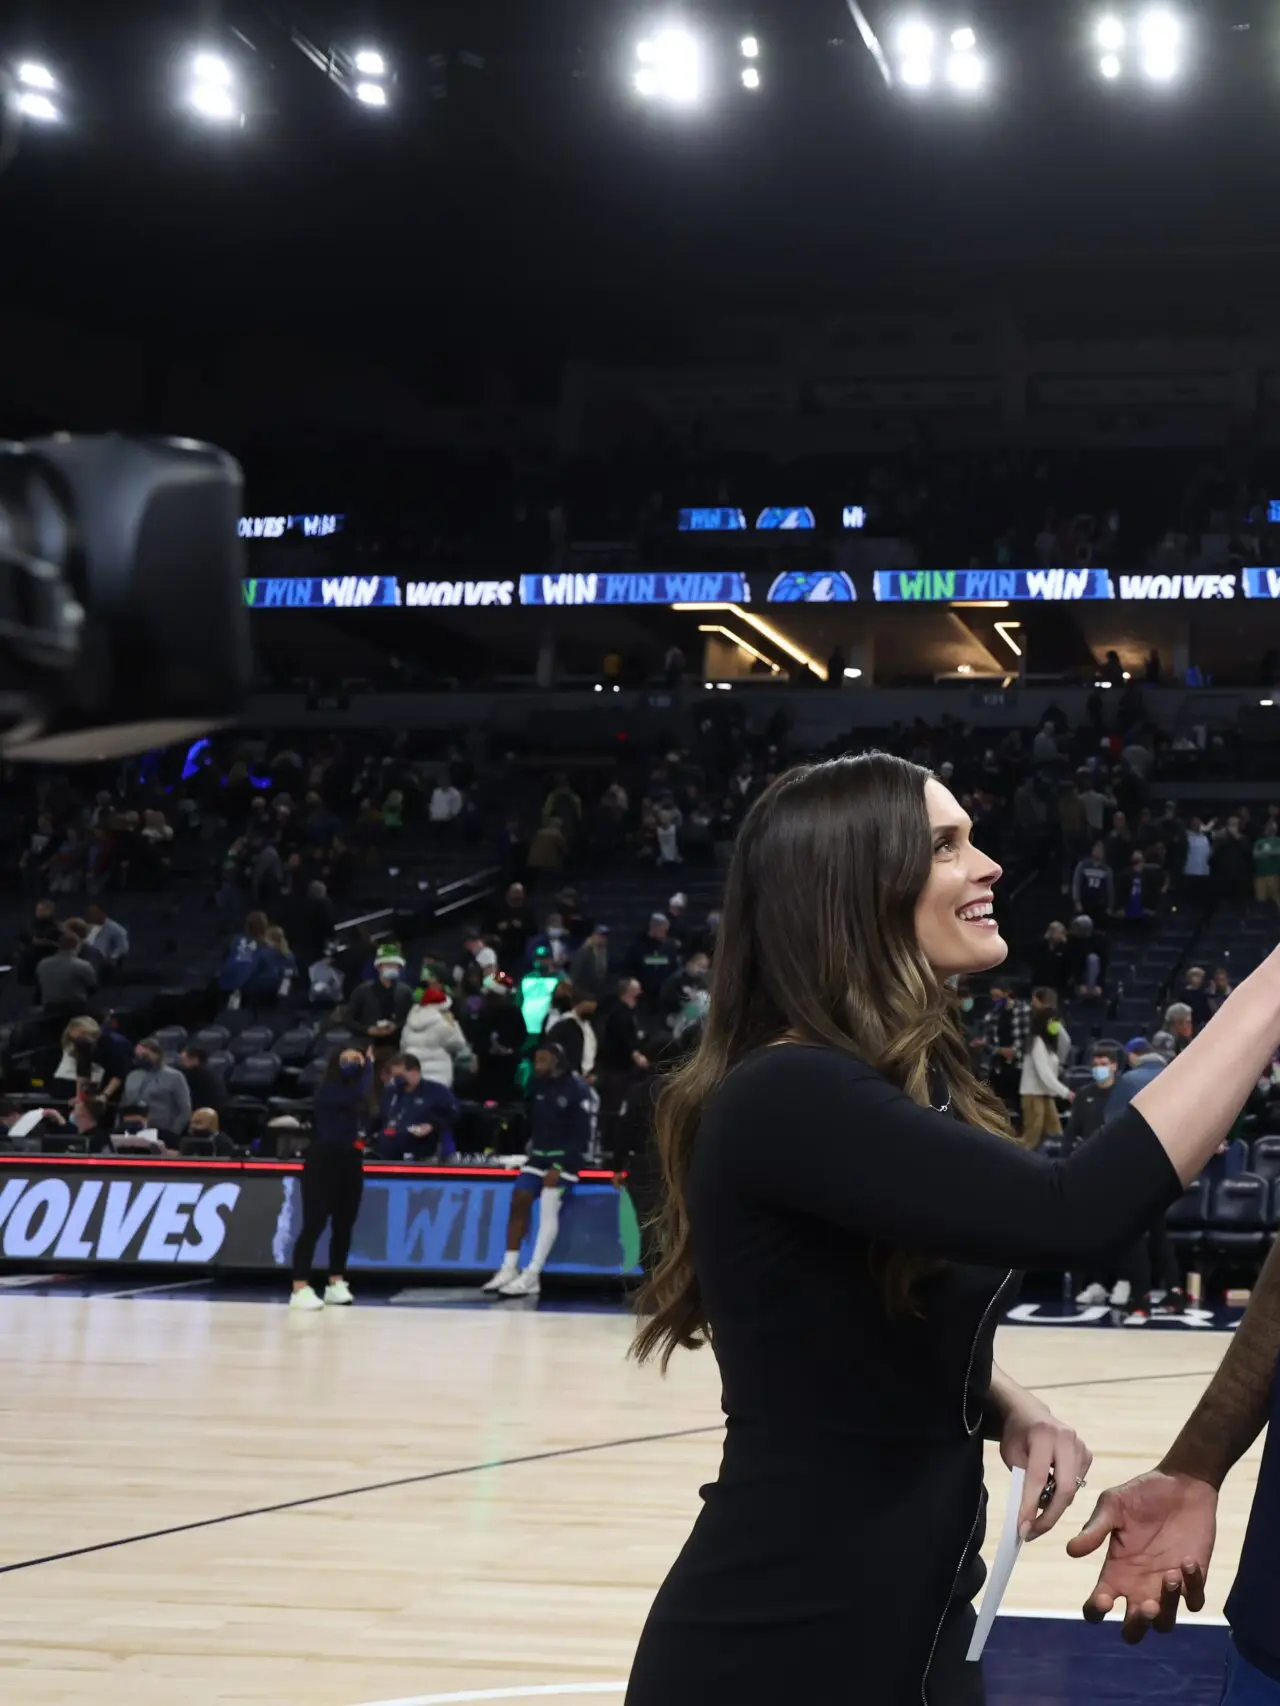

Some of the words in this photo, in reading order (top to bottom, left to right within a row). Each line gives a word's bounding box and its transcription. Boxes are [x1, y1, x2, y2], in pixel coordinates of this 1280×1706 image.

[237, 516, 285, 538] OLVES
[264, 578, 312, 606] WIN
[321, 576, 379, 607] WIN
[406, 581, 514, 606] WOLVES
[542, 573, 598, 605] WIN
[606, 574, 653, 604] WIN
[665, 574, 724, 603] WIN
[900, 570, 956, 600] WIN
[965, 570, 1017, 600] WIN
[1026, 568, 1089, 600] WIN
[1119, 575, 1236, 600] WOLVES
